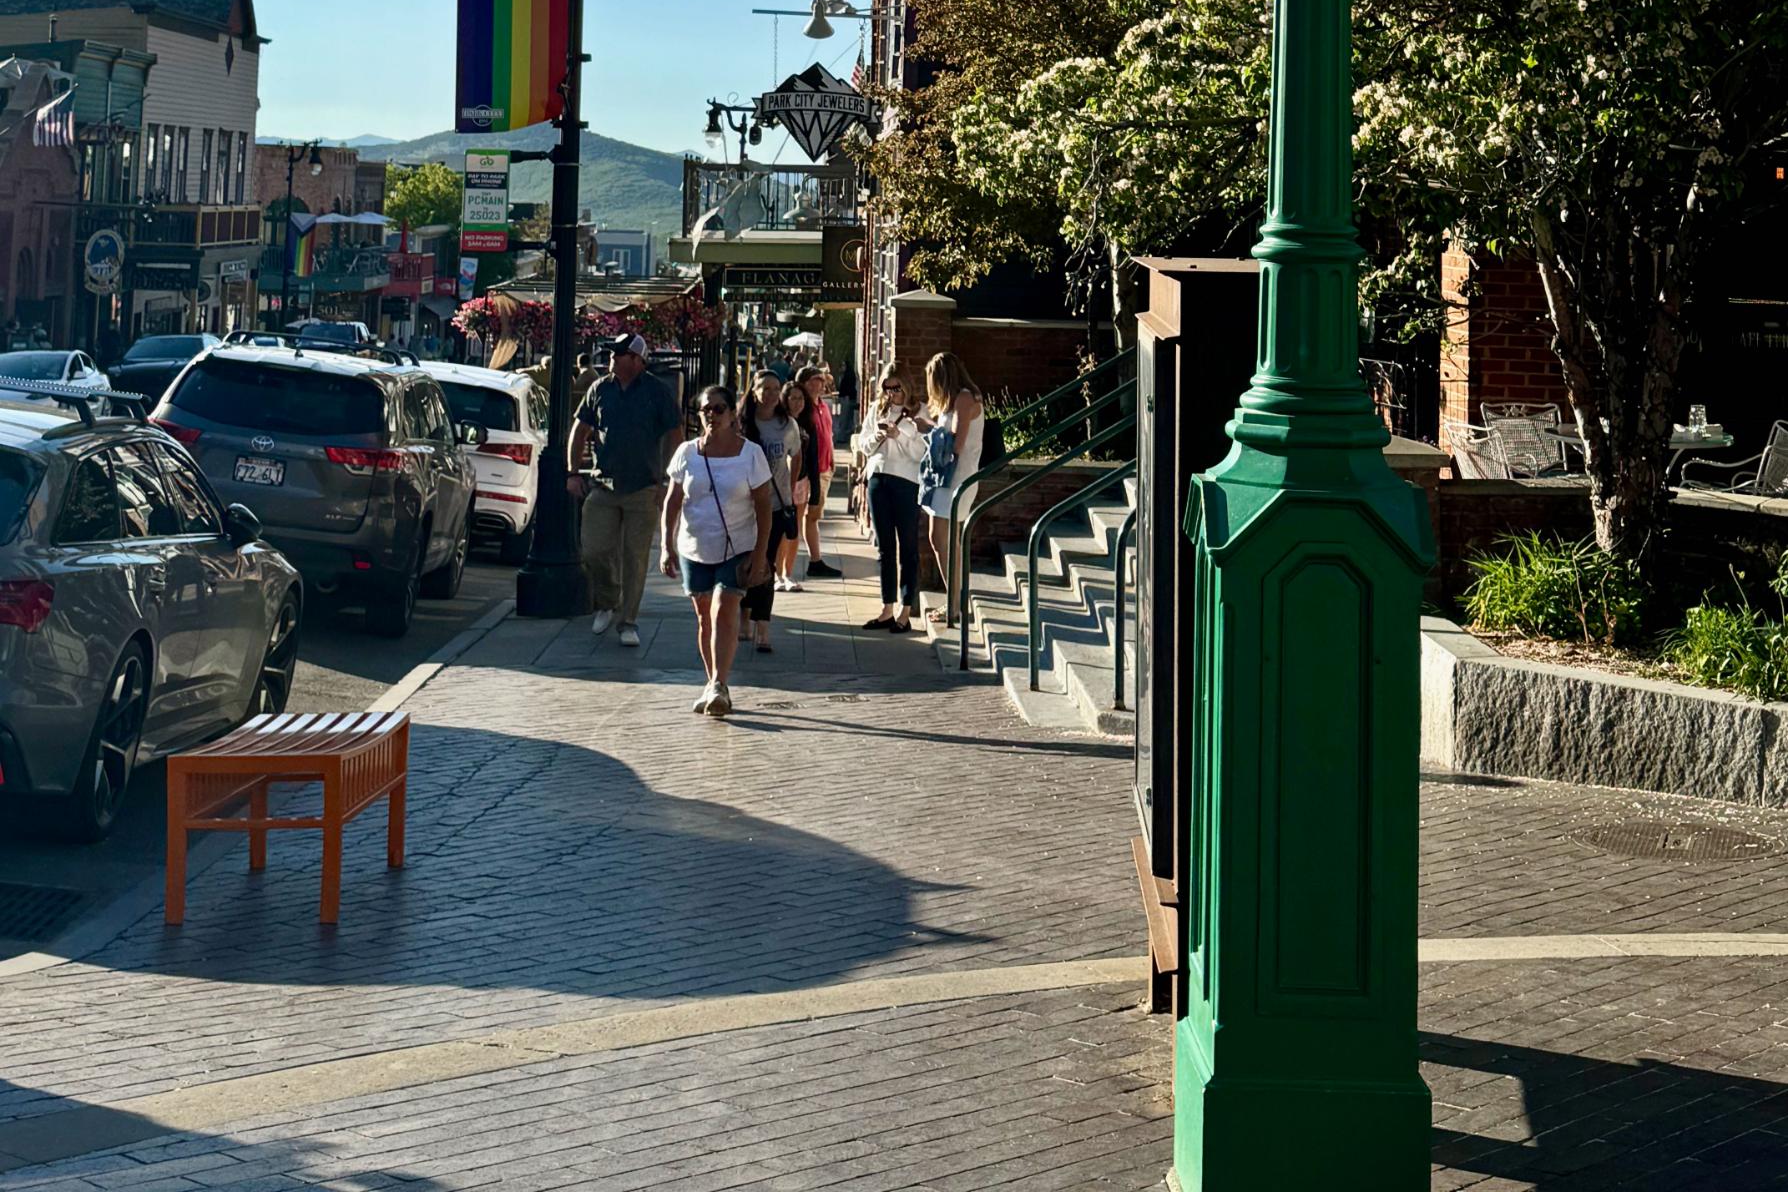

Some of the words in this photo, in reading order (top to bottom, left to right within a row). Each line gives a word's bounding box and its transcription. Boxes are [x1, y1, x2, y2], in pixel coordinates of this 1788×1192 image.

[768, 94, 792, 109] PARK
[794, 94, 815, 108] CITY
[817, 95, 865, 113] JEWELERS
[468, 196, 504, 206] PCMAIN
[470, 210, 501, 220] 25023
[742, 272, 820, 284] FLANAG
